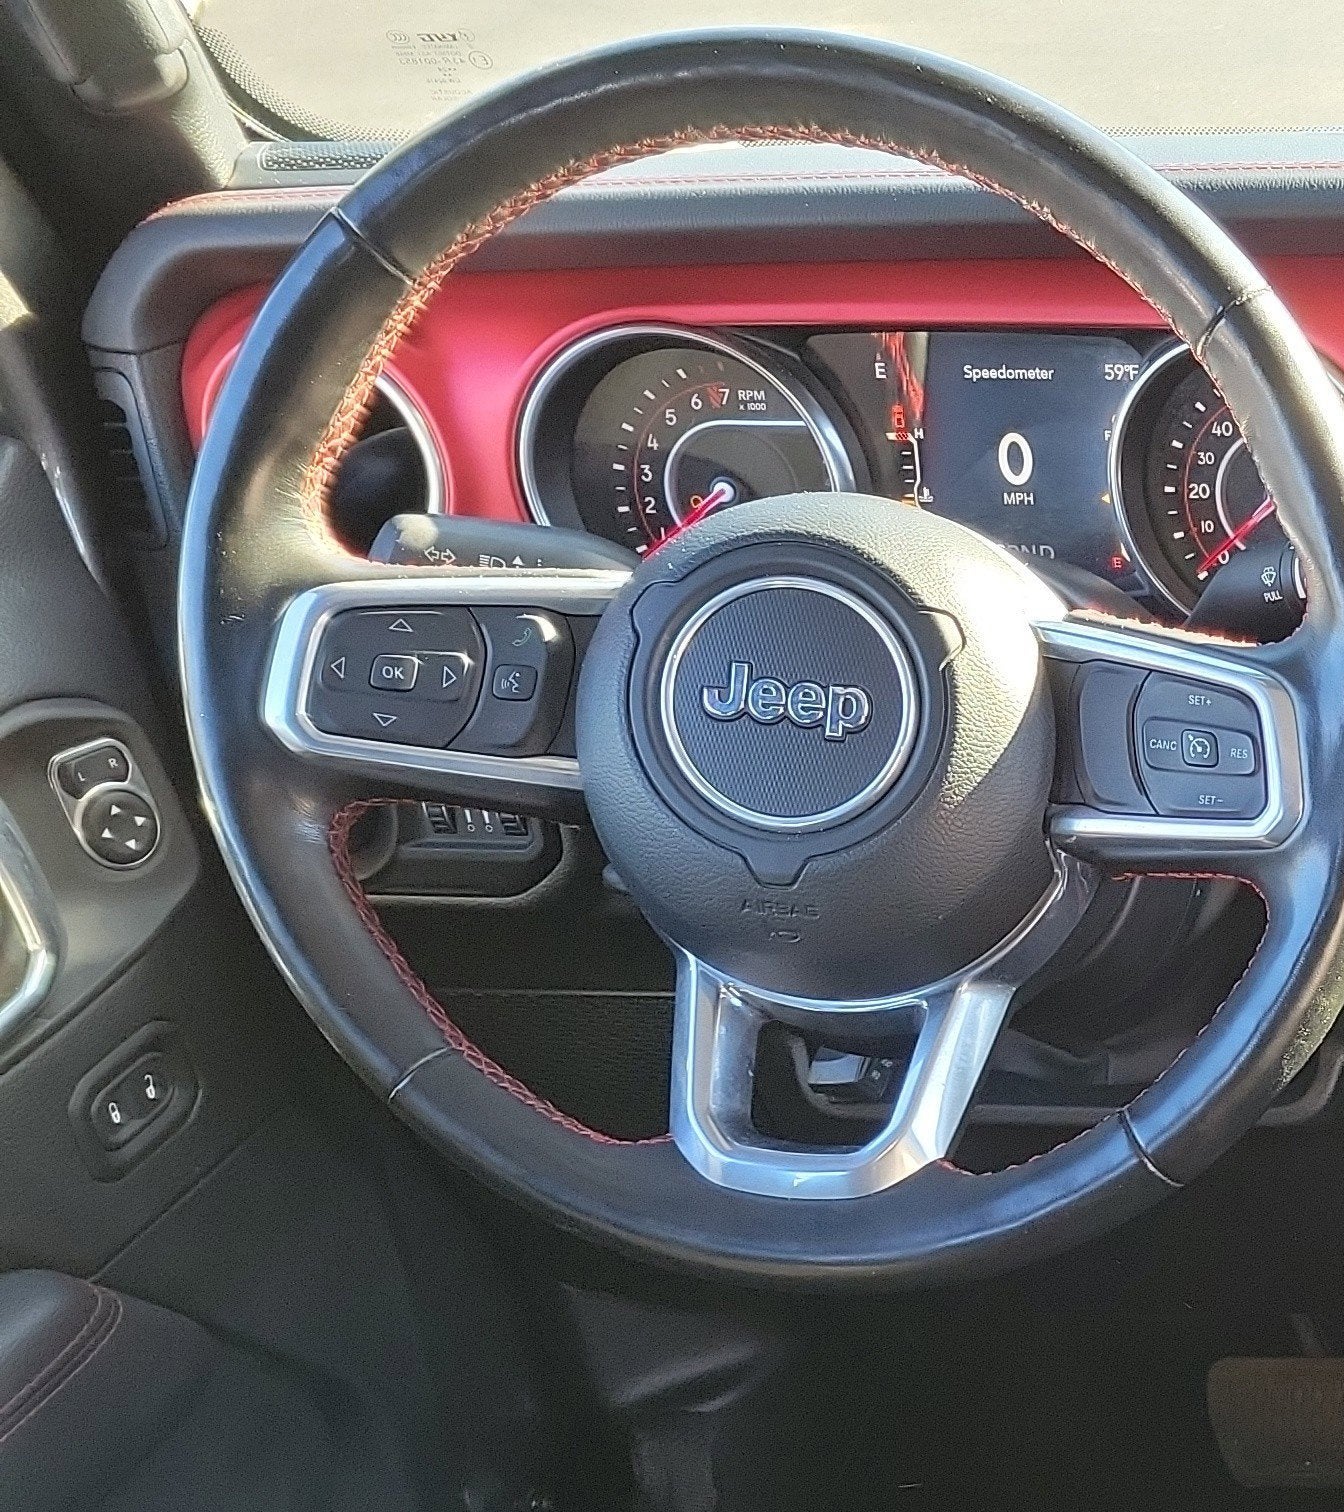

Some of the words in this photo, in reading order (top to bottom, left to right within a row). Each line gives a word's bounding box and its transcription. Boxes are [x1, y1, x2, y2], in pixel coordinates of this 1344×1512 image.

[874, 363, 887, 379] E
[963, 365, 1055, 381] Speedometer
[1104, 364, 1140, 381] 59°F
[690, 393, 702, 410] 6
[718, 389, 730, 405] 7
[737, 390, 766, 401] RPM
[746, 402, 767, 411] 1000
[665, 409, 677, 426] 5
[914, 428, 924, 439] H
[1211, 421, 1233, 437] 40
[647, 434, 659, 451] 4
[998, 432, 1034, 486] 0
[1197, 452, 1215, 466] 30
[640, 465, 653, 482] 3
[1003, 492, 1034, 505] MPH
[1188, 483, 1211, 500] 20
[644, 497, 657, 514] 2
[1200, 520, 1215, 533] 10
[1263, 592, 1283, 603] PULL
[382, 665, 404, 680] OK
[702, 660, 873, 741] Jeep
[1149, 738, 1178, 751] CANC
[1230, 748, 1249, 759] RES
[108, 757, 119, 769] R
[77, 771, 87, 782] L
